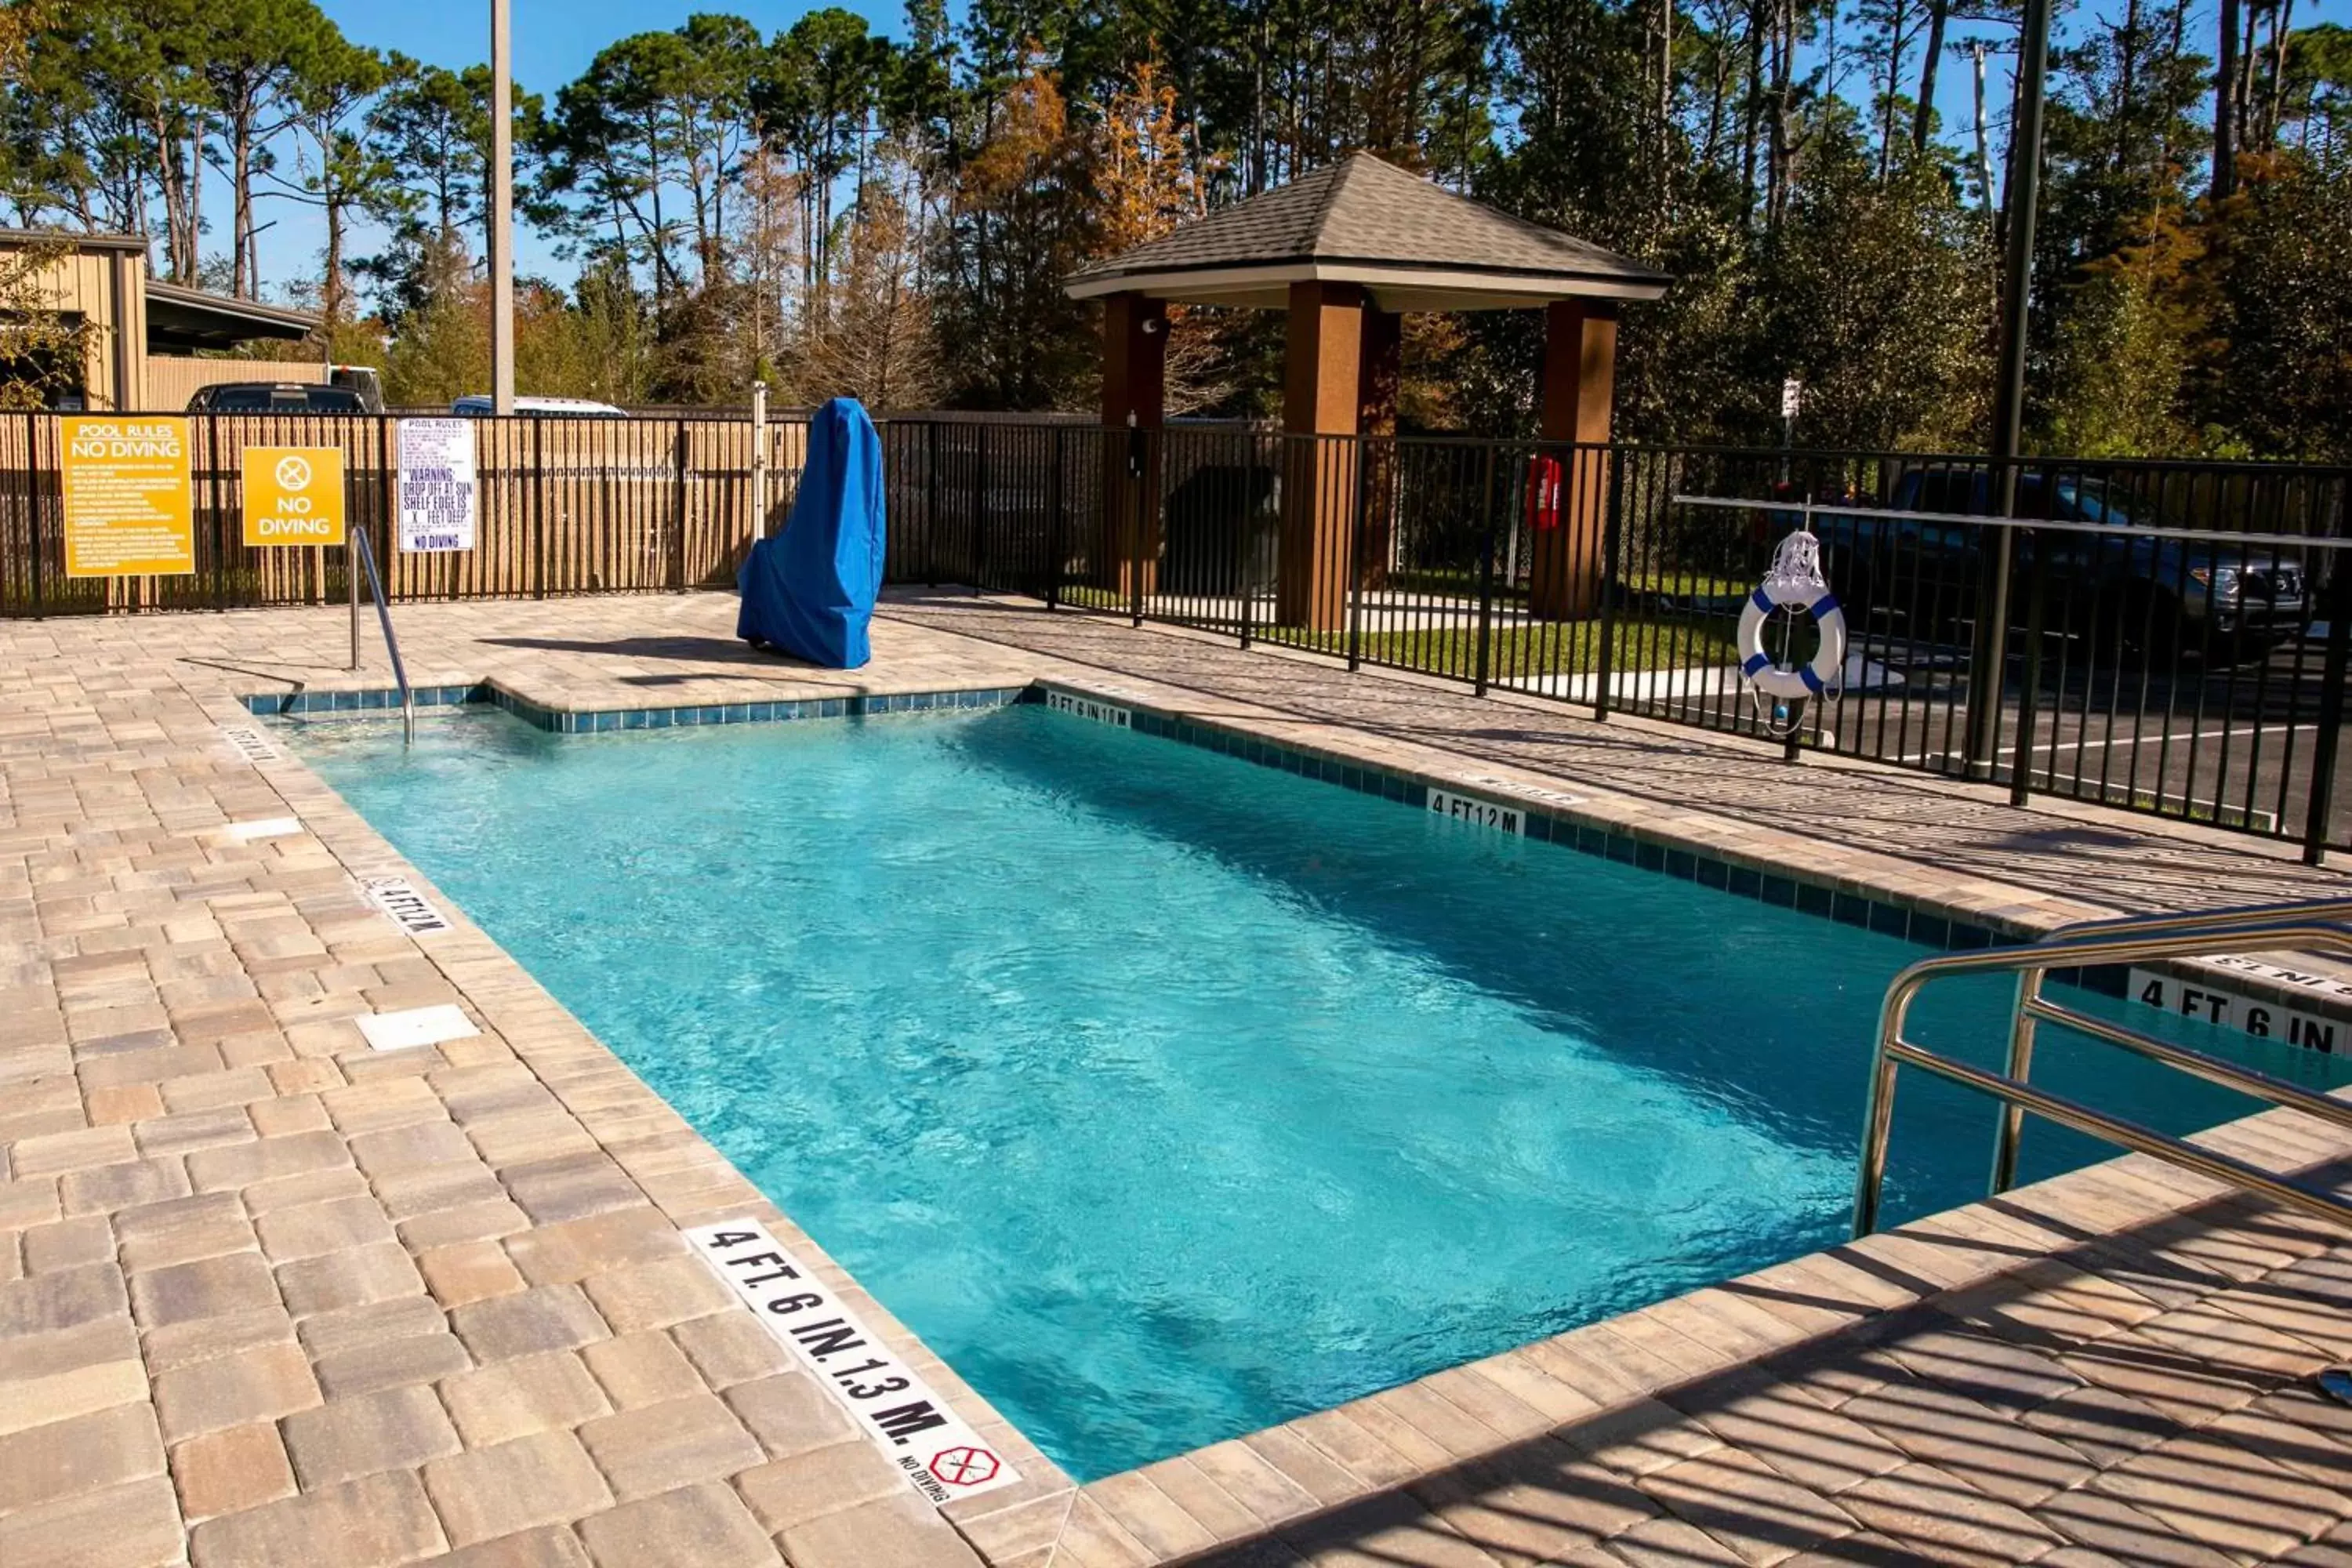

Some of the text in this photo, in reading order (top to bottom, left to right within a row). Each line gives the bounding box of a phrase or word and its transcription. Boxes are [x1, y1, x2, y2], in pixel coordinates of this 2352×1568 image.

[79, 424, 173, 437] POOL RULES
[408, 419, 431, 428] POOL
[72, 441, 180, 458] NO DIVING
[404, 481, 472, 496] DROP OFF AT SUN
[277, 496, 312, 514] NO
[404, 495, 466, 510] SHELF EDGE IS
[412, 510, 418, 524] X
[427, 510, 445, 524] FEET
[258, 517, 330, 535] DIVING
[414, 534, 459, 549] NO DIVING
[1061, 696, 1073, 711] FT
[1087, 704, 1098, 720] IN
[1117, 711, 1127, 726] M
[1432, 794, 1444, 813] 4
[1450, 799, 1473, 822] FT
[1501, 811, 1517, 833] M
[384, 897, 424, 909] FT
[406, 921, 445, 933] M
[2271, 971, 2325, 986] IN
[2141, 979, 2334, 1054] 4 FT 6 IN
[708, 1232, 949, 1446] 4 FT. 6 IN. 1.3 M.
[896, 1454, 951, 1503] NO DIVING
